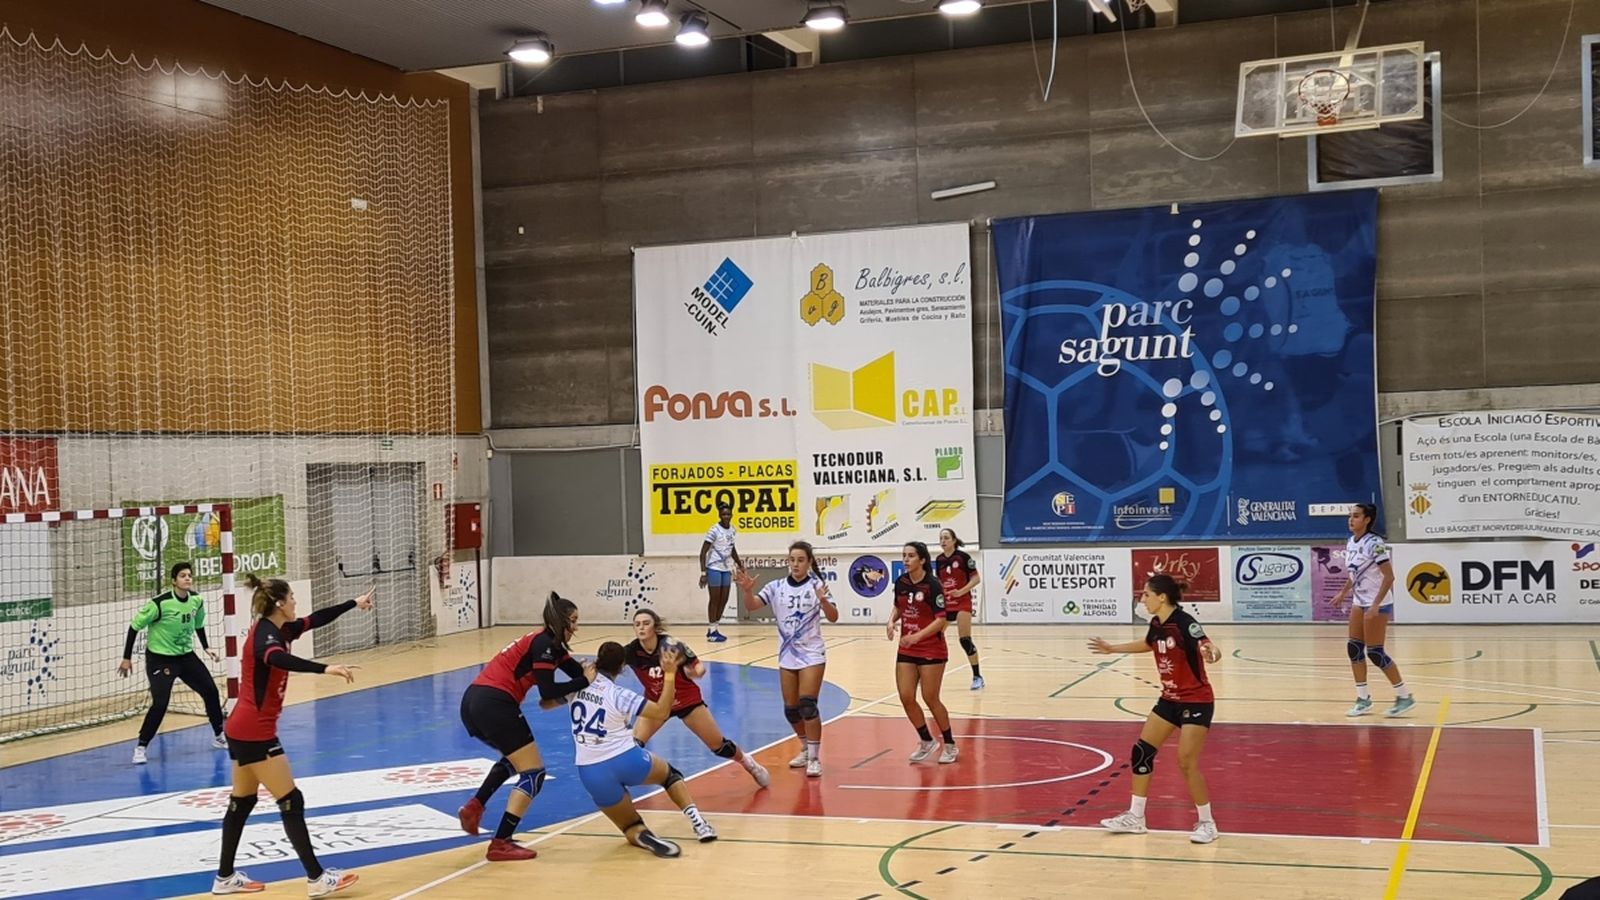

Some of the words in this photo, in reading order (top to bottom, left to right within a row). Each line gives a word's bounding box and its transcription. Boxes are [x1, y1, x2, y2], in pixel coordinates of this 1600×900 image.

[855, 267, 932, 295] Balbigres,
[691, 286, 729, 329] MODEL
[684, 301, 718, 337] -CUIN-
[1100, 299, 1194, 342] parc
[1058, 325, 1196, 377] sagunt
[902, 388, 958, 418] CAP
[1453, 435, 1472, 444] una
[1474, 432, 1507, 442] Escola
[1510, 432, 1532, 442] (una
[1534, 432, 1568, 443] Escola
[1570, 435, 1585, 444] de
[813, 451, 883, 467] TECNODUR
[1409, 452, 1441, 461] Estem
[1443, 450, 1478, 459] tots/es
[1531, 450, 1598, 462] monitors/es,
[653, 466, 724, 480] FORJADOS
[739, 464, 793, 477] PLACAS
[813, 467, 900, 485] VALENCIANA,
[903, 467, 927, 482] S.L.
[1432, 464, 1496, 476] jugadors/es.
[1543, 463, 1558, 472] als
[1560, 464, 1594, 475] adults
[0, 466, 51, 507] ANA
[1437, 479, 1477, 489] tinguen
[1481, 477, 1491, 486] el
[653, 480, 795, 515] TECOPAL
[1458, 494, 1481, 503] d'un
[1113, 505, 1170, 515] Infoinvest
[1250, 501, 1296, 511] GENERALITAT
[738, 516, 795, 529] SEGORBE
[1251, 510, 1296, 521] VALENCIANA
[1425, 526, 1446, 534] CLUB
[1573, 528, 1585, 536] DE
[195, 551, 278, 577] IBEDROLA
[1022, 554, 1061, 562] Comunitat
[1063, 553, 1105, 561] Valenciana
[1022, 563, 1105, 576] COMUNITAT
[1242, 556, 1297, 582] Sugar's
[1461, 560, 1555, 591] DFM
[1029, 577, 1047, 590] DE
[1051, 576, 1116, 590] L'ESPORT
[595, 587, 634, 600] sagunt
[908, 592, 914, 604] 3
[1462, 593, 1503, 604] RENT
[1508, 593, 1519, 604] A
[1523, 593, 1557, 604] CAR
[787, 594, 801, 609] 31
[0, 659, 36, 680] agunt
[648, 666, 663, 679] 42
[571, 701, 607, 738] 94
